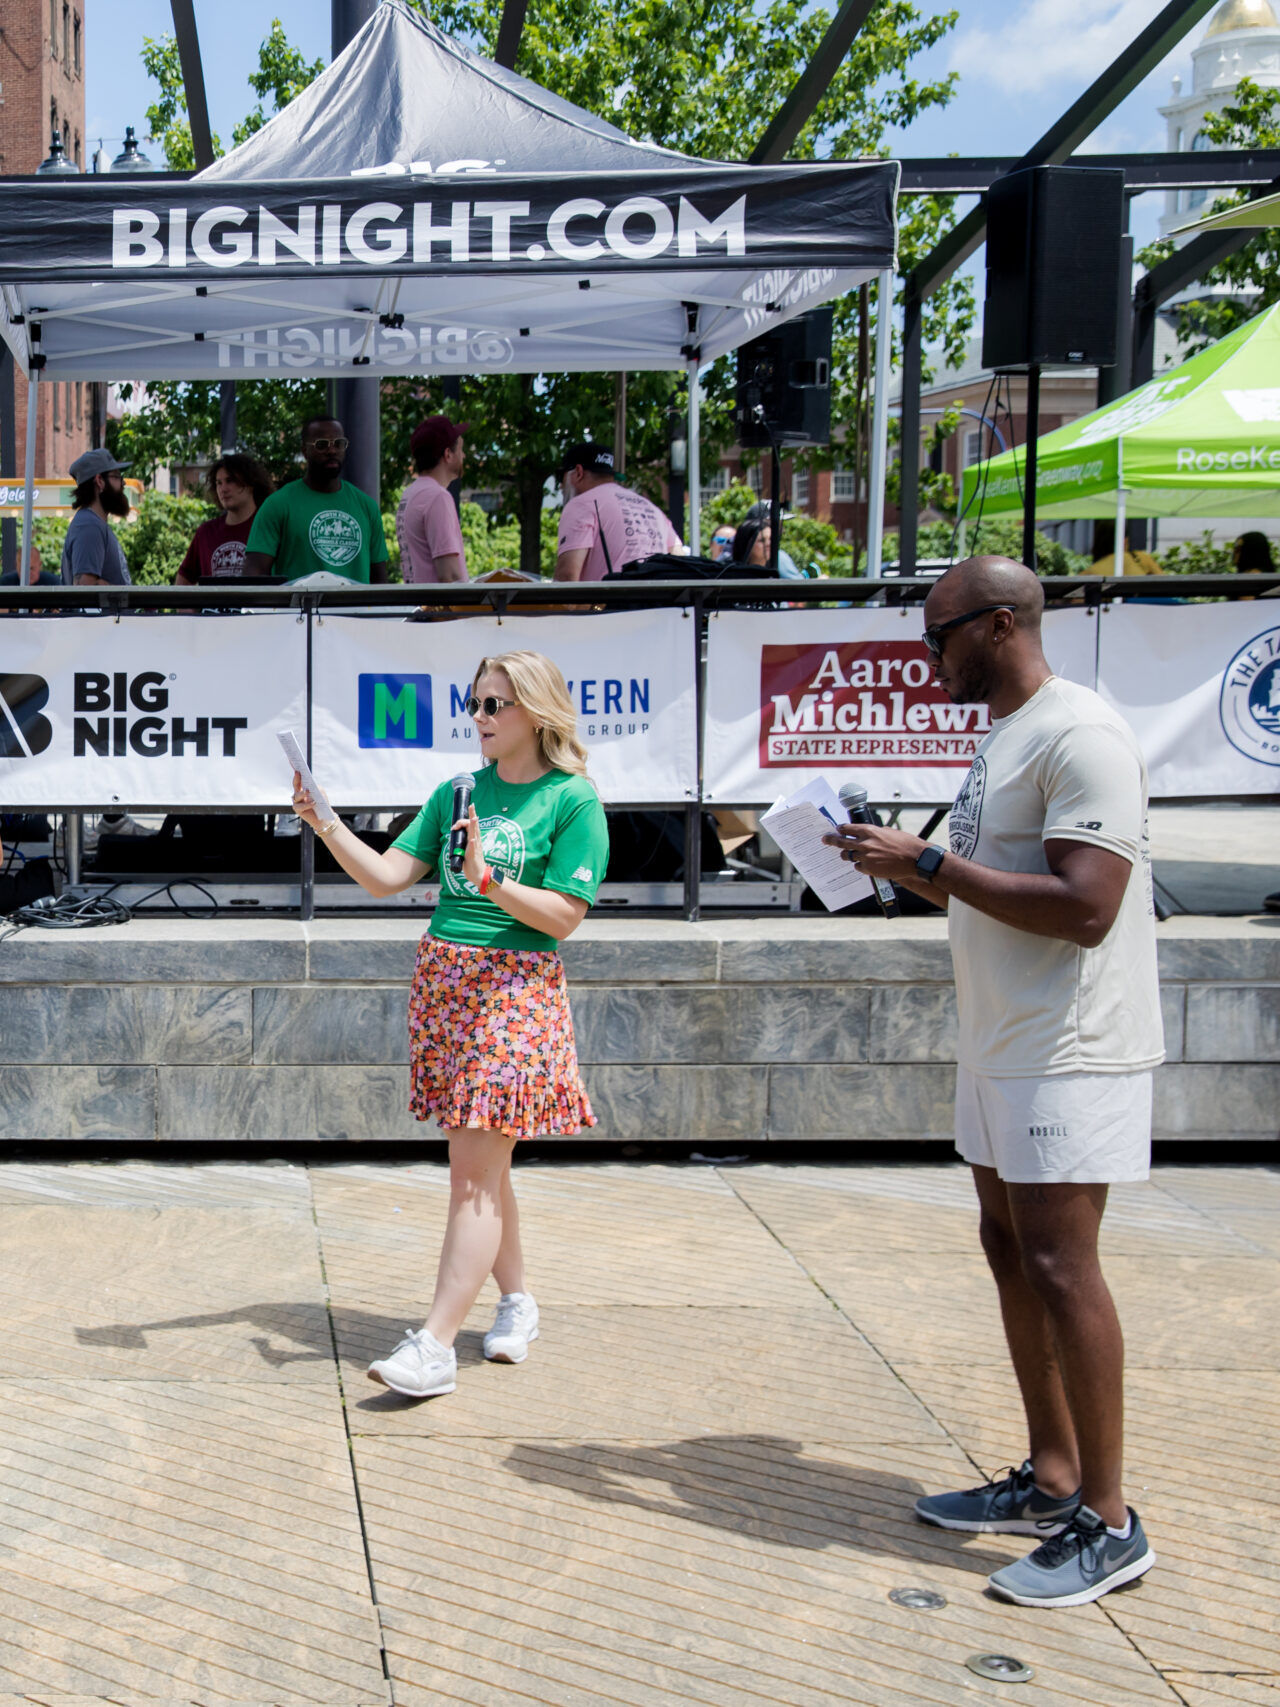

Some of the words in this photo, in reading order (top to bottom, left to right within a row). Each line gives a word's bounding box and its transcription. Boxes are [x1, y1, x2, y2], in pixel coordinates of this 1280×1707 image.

[112, 193, 747, 269] BIGNIGHT.COM
[809, 651, 943, 689] Aaro
[1230, 650, 1263, 688] THE
[74, 671, 169, 713] BIG
[74, 716, 248, 757] NIGHT
[588, 723, 650, 736] GROUP
[772, 740, 836, 755] STATE
[840, 739, 982, 755] REPRESENTA
[479, 818, 503, 829] ORTH
